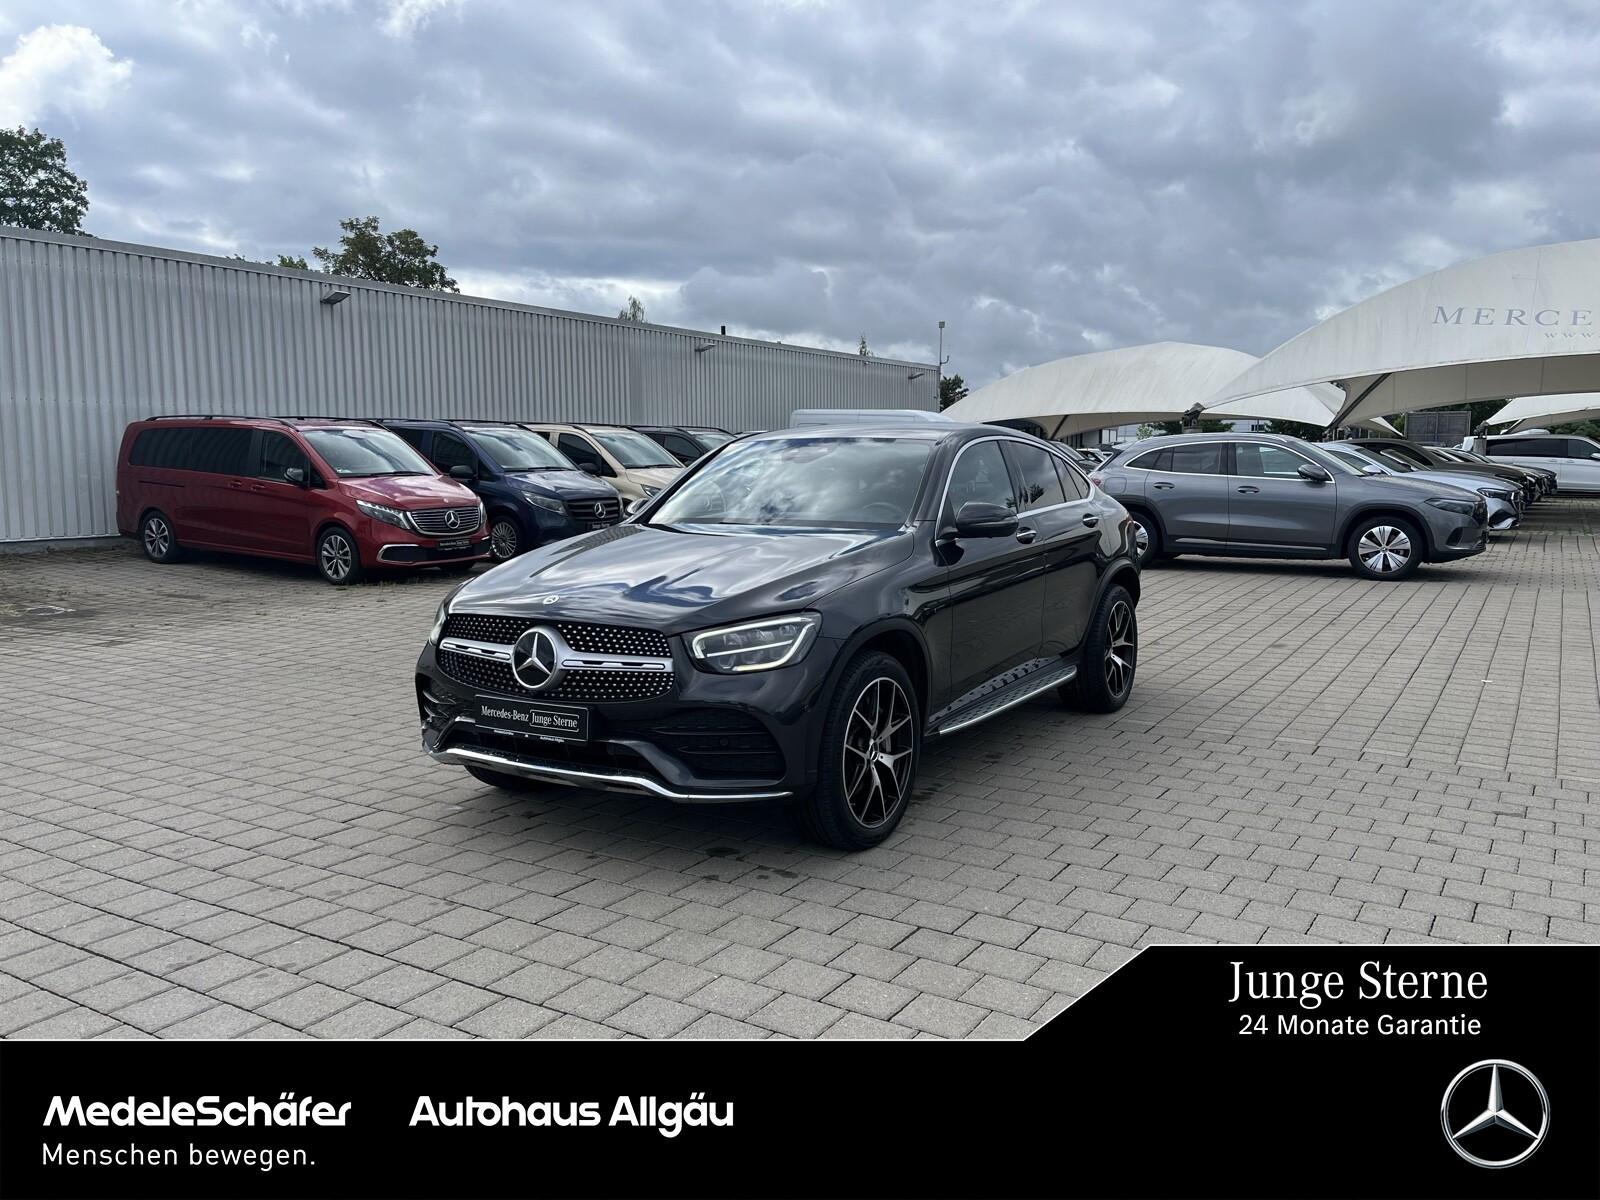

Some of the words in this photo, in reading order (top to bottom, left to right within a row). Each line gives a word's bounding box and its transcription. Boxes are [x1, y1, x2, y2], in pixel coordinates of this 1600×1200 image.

[1432, 306, 1592, 326] MERCE
[480, 705, 529, 722] Mercedes-Benz
[531, 712, 552, 726] Junge
[553, 716, 578, 728] Sterne
